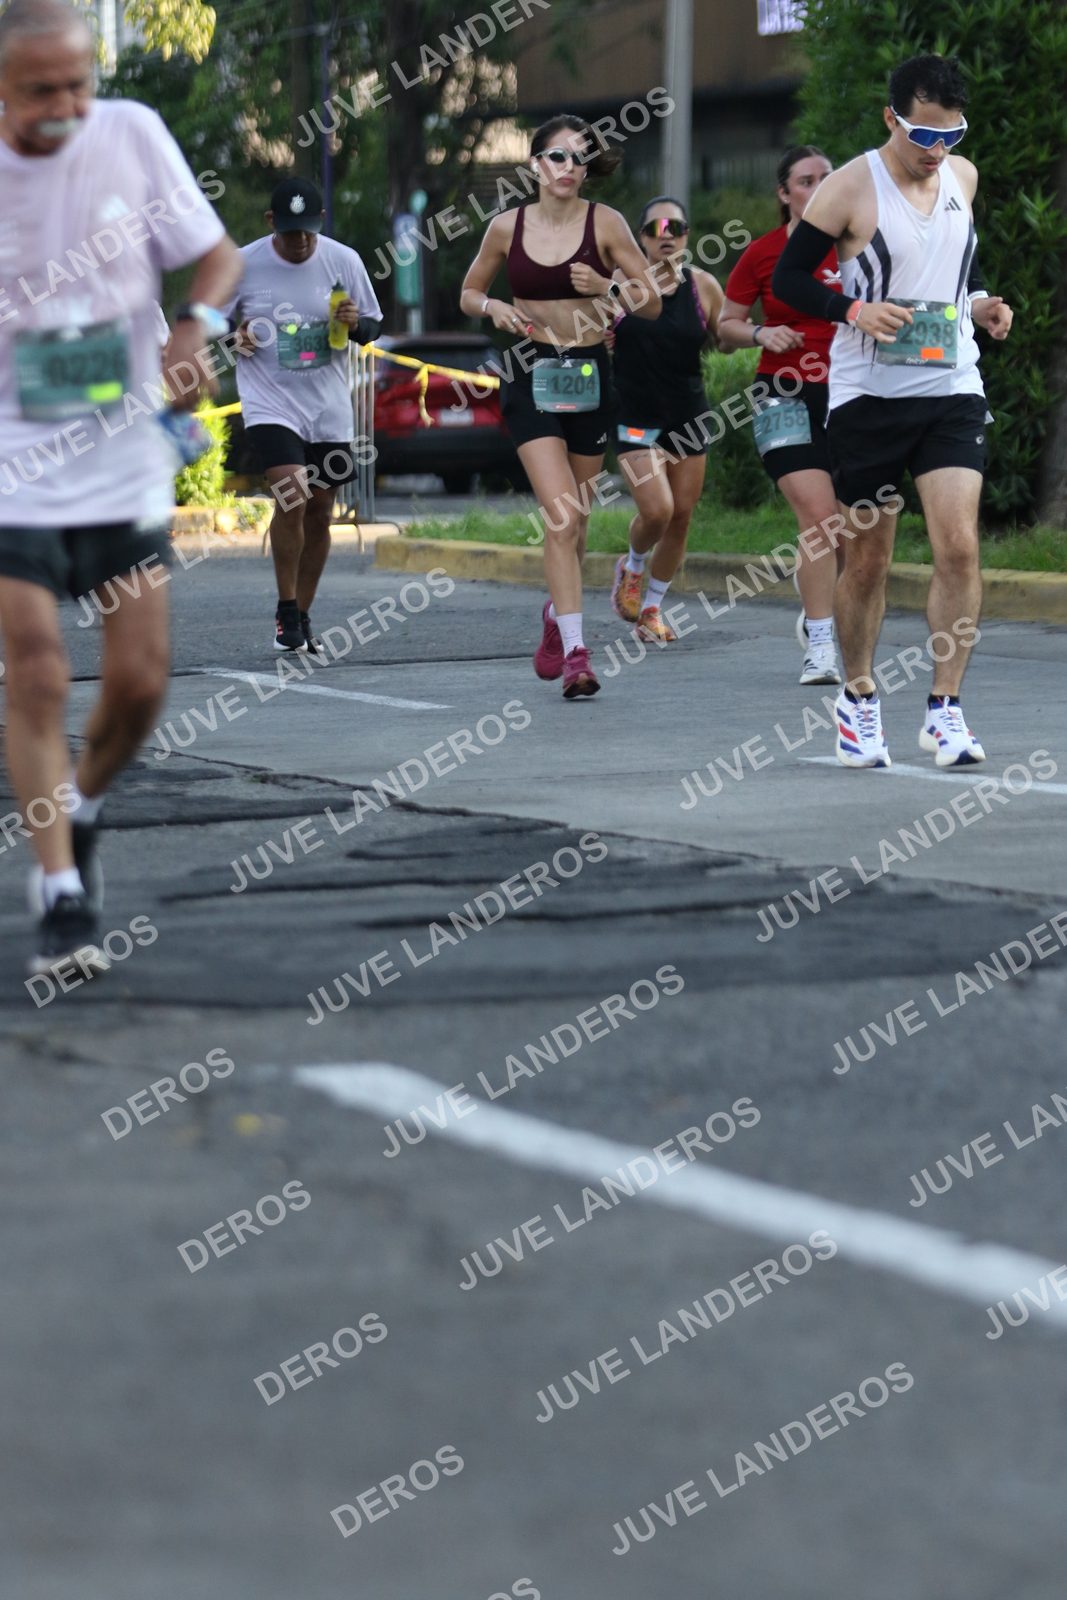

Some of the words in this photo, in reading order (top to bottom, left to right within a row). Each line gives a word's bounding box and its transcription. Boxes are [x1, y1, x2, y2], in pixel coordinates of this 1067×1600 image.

[899, 320, 956, 348] 2938
[551, 374, 596, 395] 1204
[762, 408, 807, 434] 2758
